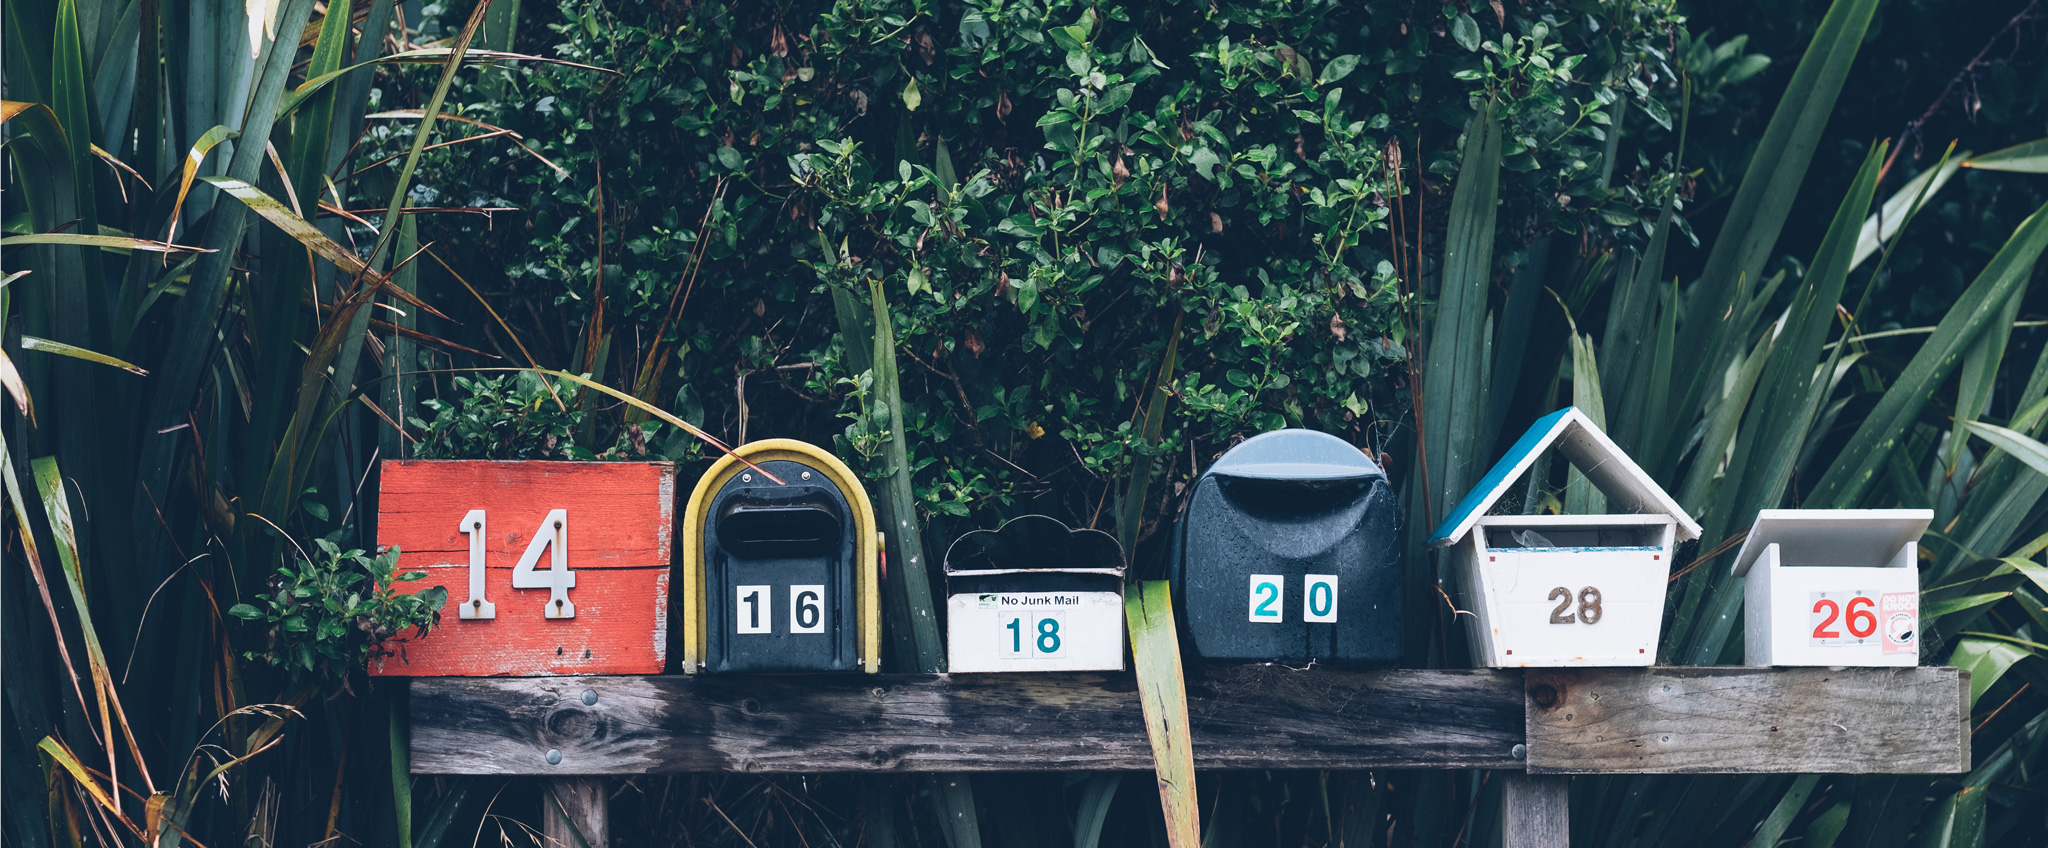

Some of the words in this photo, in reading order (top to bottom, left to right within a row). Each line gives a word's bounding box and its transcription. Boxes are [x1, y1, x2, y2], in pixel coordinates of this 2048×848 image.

[459, 509, 576, 619] 14
[743, 590, 820, 628] 16
[1001, 596, 1018, 605] No
[1021, 596, 1051, 605] Junk
[1054, 596, 1079, 605] Mail
[1254, 581, 1333, 617] 20
[1548, 586, 1603, 625] 28
[1812, 596, 1877, 638] 26
[1883, 595, 1897, 603] DO
[1006, 617, 1061, 653] 18
